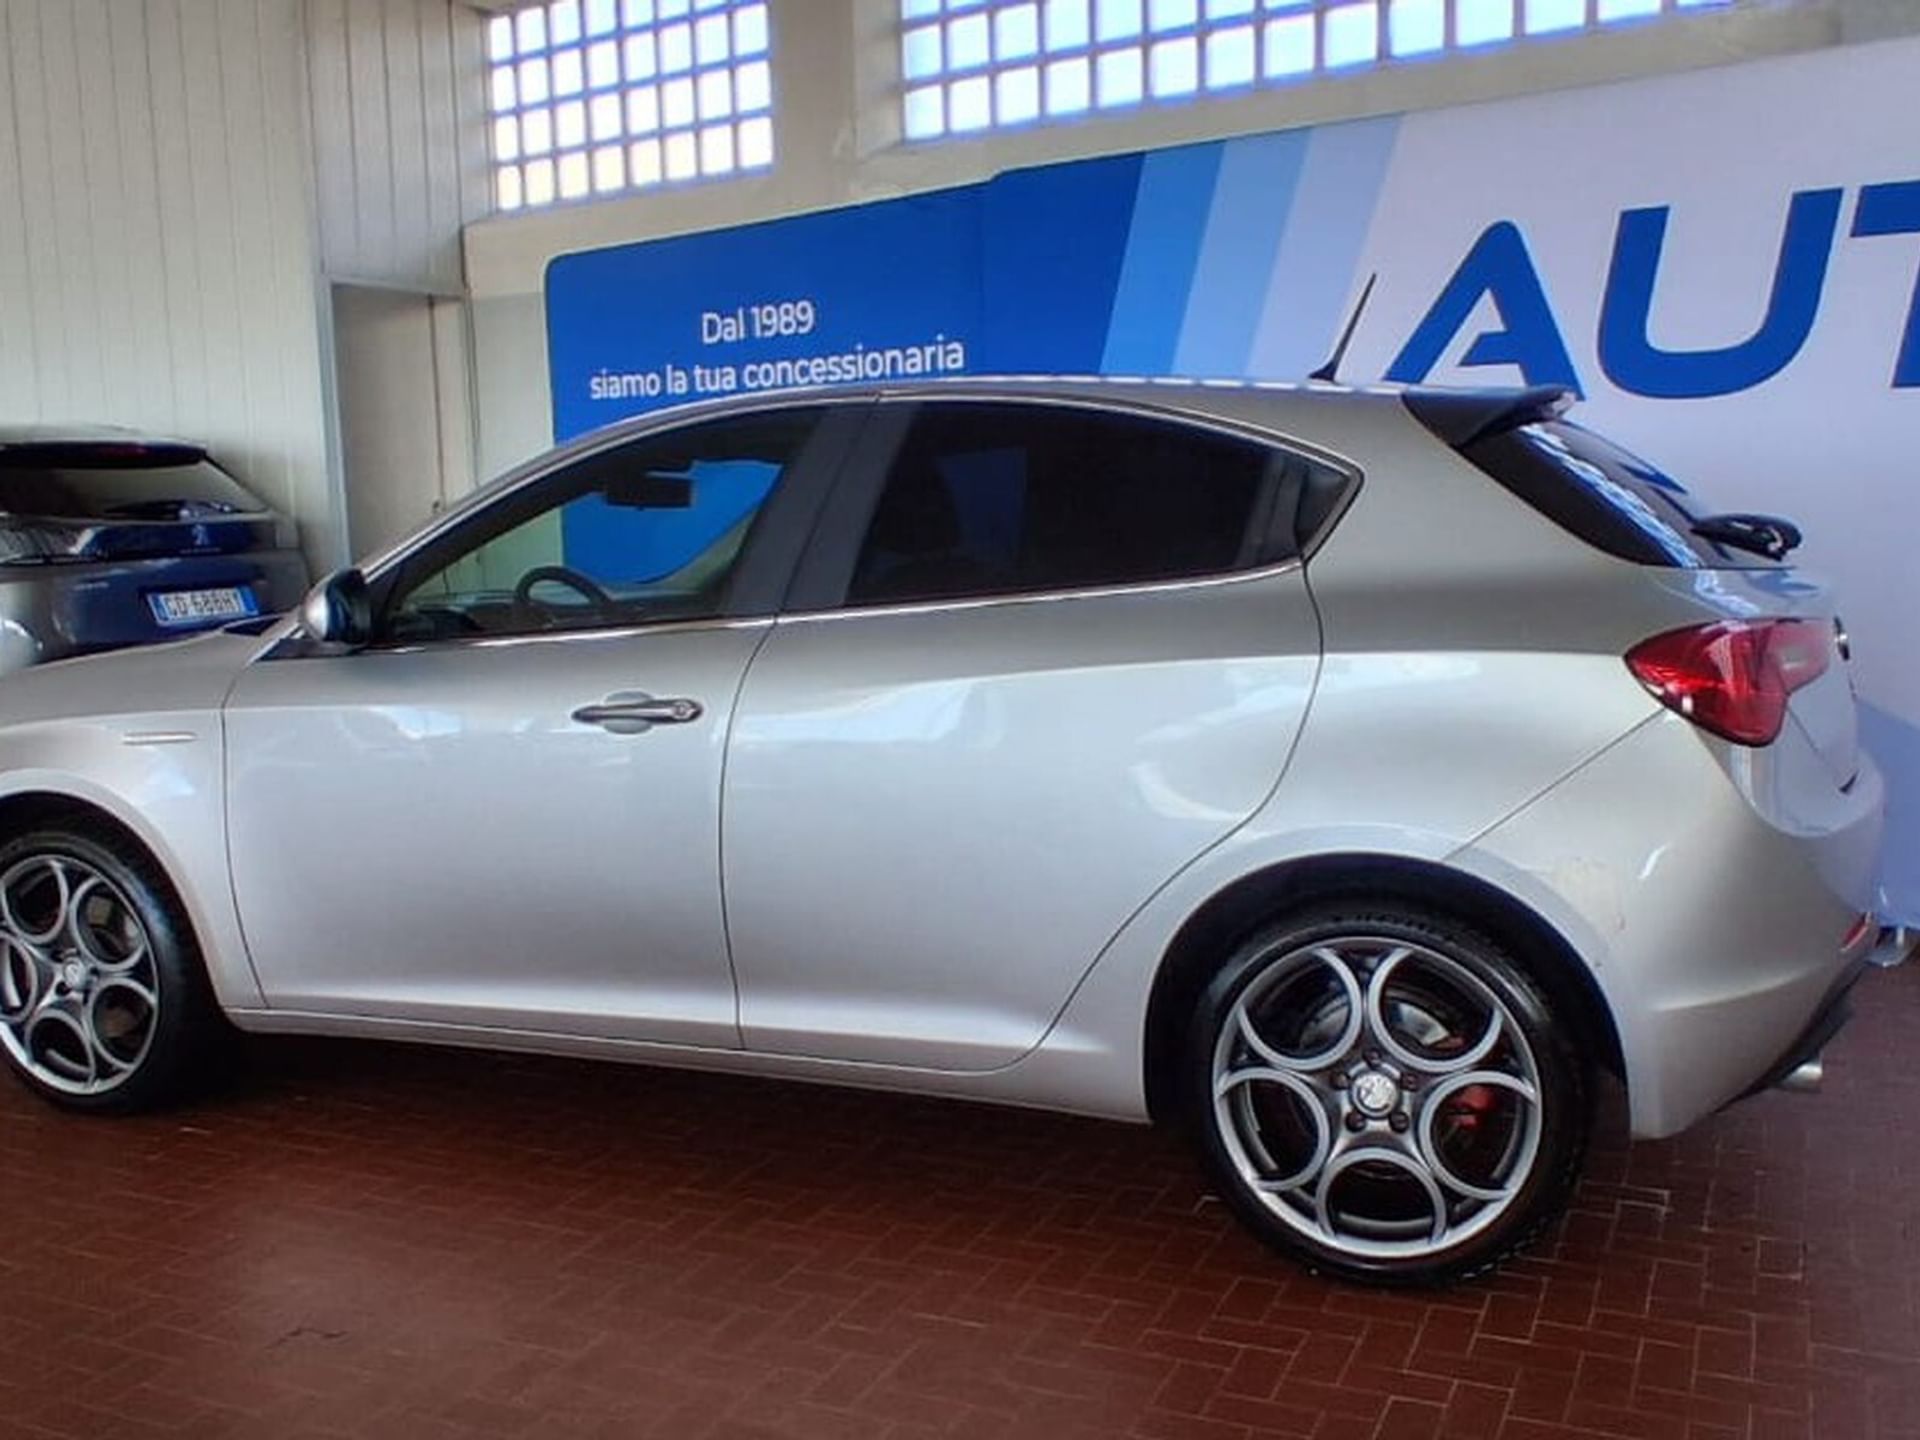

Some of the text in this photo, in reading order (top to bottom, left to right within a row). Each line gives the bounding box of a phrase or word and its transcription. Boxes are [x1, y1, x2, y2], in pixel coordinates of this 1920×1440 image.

[701, 300, 815, 344] Dal 1989
[589, 333, 965, 400] siamo la tua concessionaria
